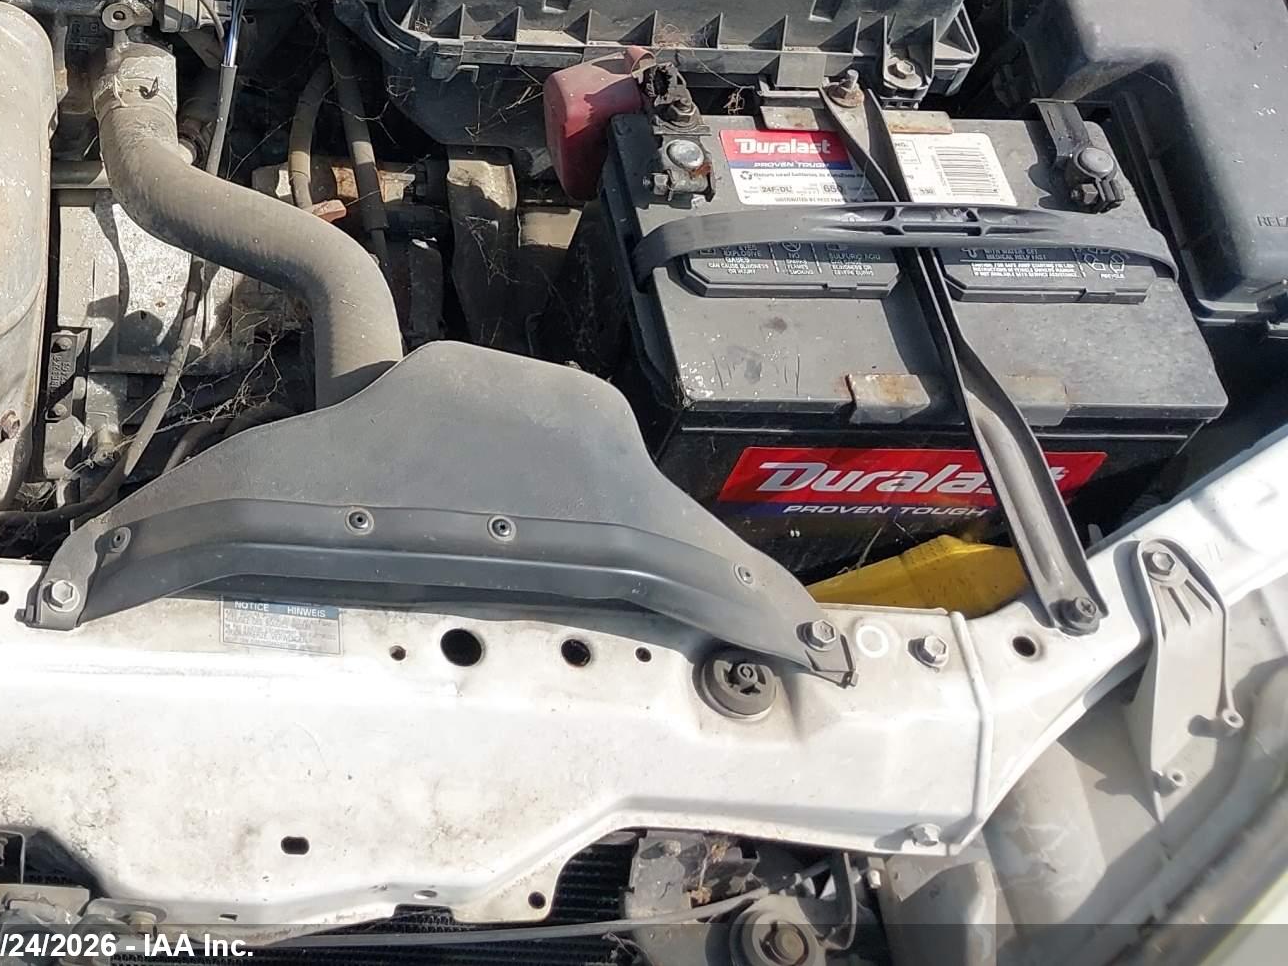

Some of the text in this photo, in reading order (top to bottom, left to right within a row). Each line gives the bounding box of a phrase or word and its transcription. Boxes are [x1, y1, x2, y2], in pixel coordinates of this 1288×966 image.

[734, 138, 831, 154] Duralast
[823, 184, 843, 194] 650
[723, 249, 761, 257] EXPLOSIVE
[783, 504, 990, 517] PROVEN TOUGH
[234, 601, 270, 612] NOTICE
[287, 606, 326, 618] HINWEIS
